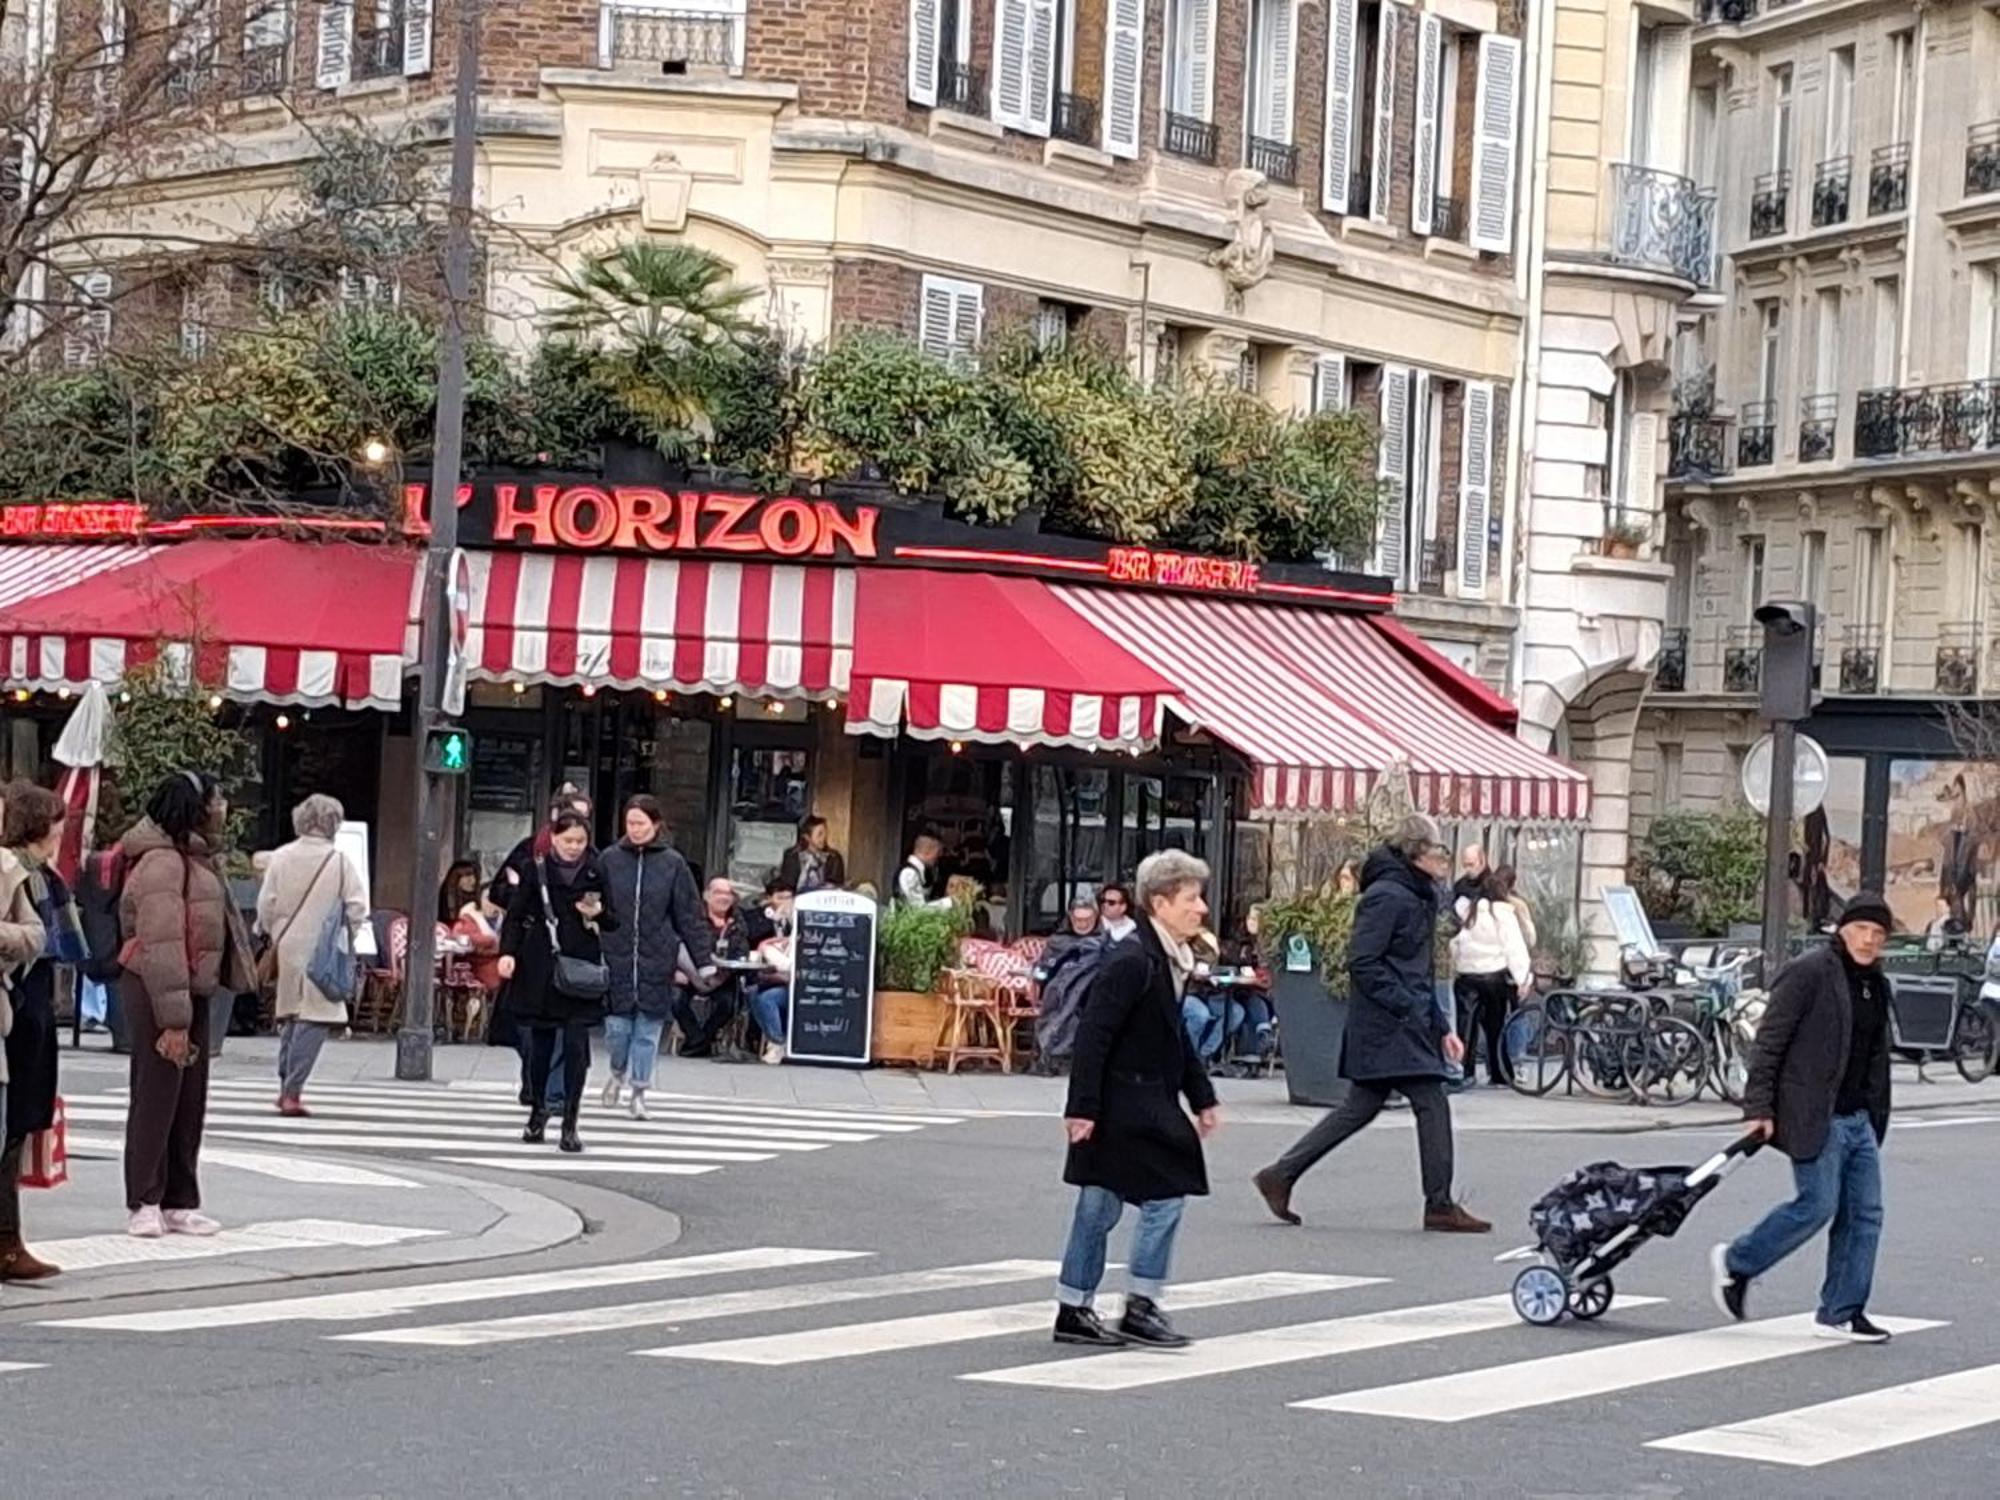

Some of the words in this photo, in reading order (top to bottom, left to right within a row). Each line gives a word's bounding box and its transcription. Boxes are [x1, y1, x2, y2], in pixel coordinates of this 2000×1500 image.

[493, 483, 879, 559] HORIZON
[1107, 547, 1151, 582] BAR
[1153, 552, 1260, 593] BRASSERIE
